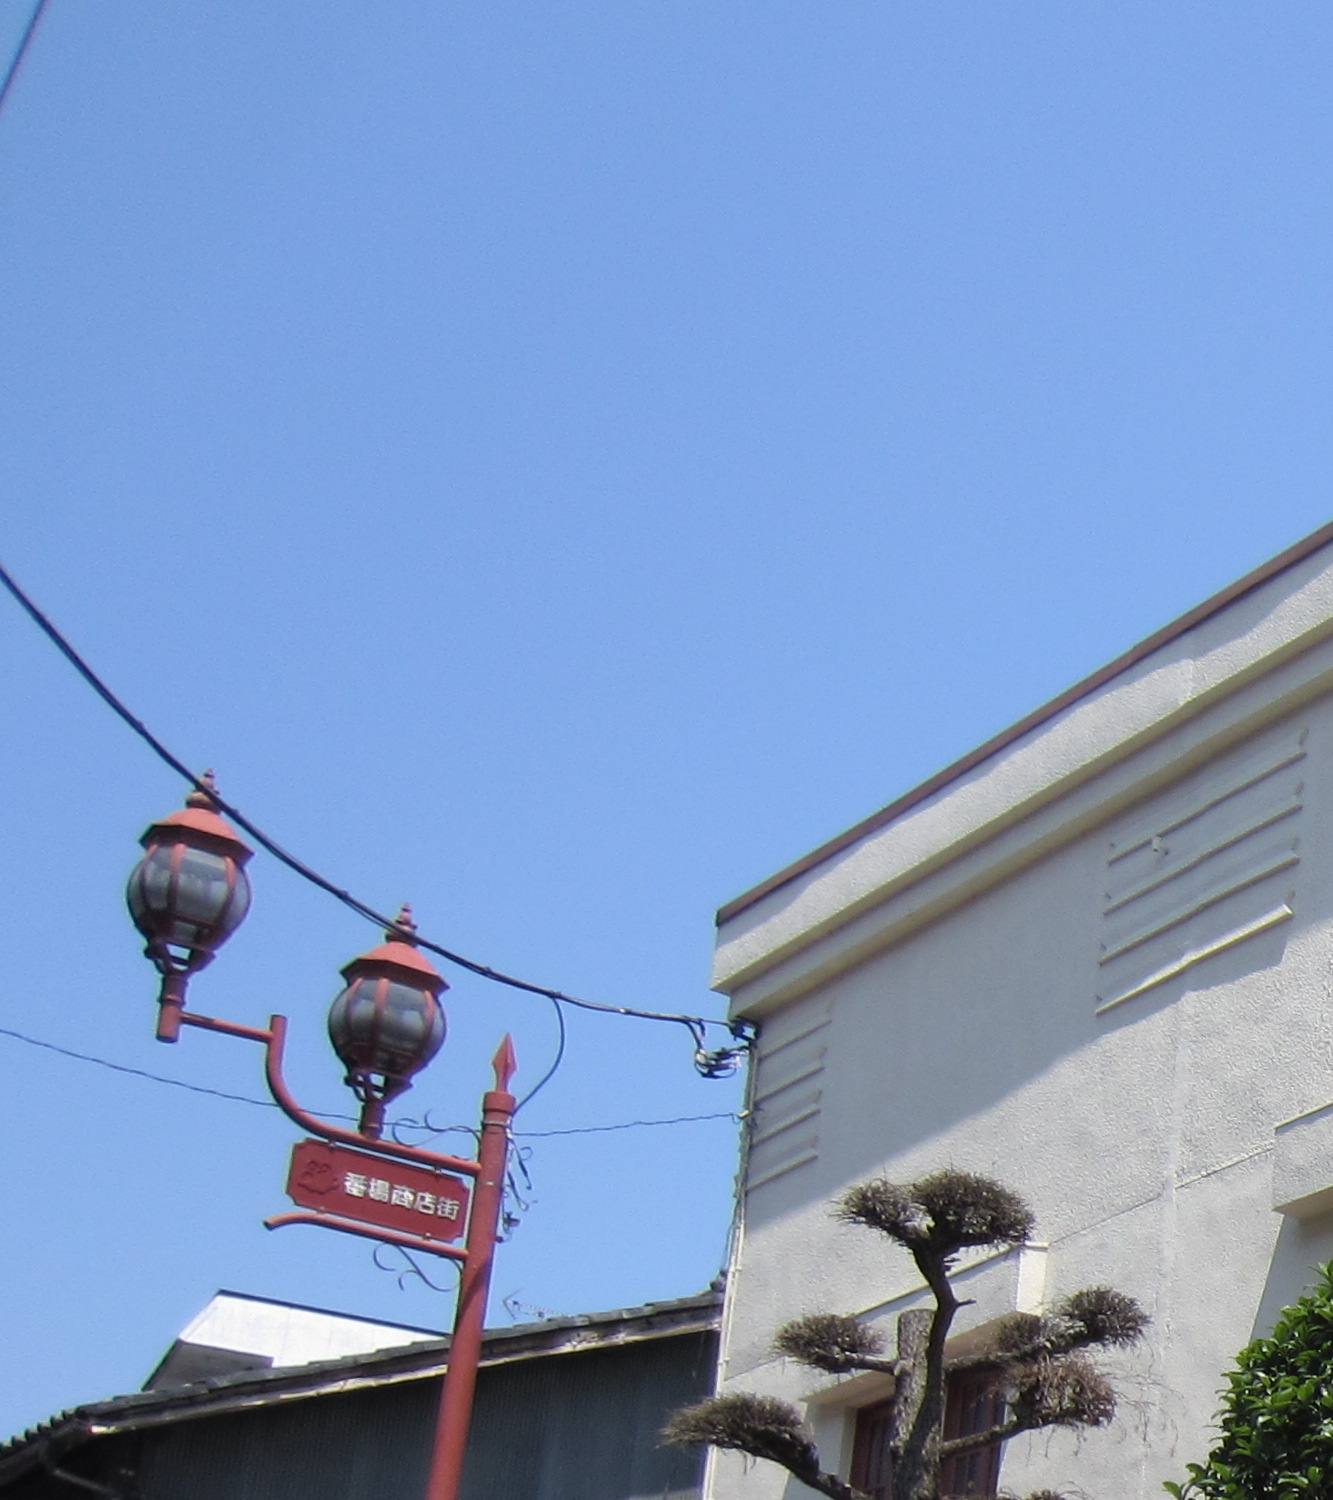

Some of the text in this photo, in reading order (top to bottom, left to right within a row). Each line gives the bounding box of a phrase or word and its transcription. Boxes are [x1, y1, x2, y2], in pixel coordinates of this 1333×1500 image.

[345, 1172, 460, 1220] 番場商店街
